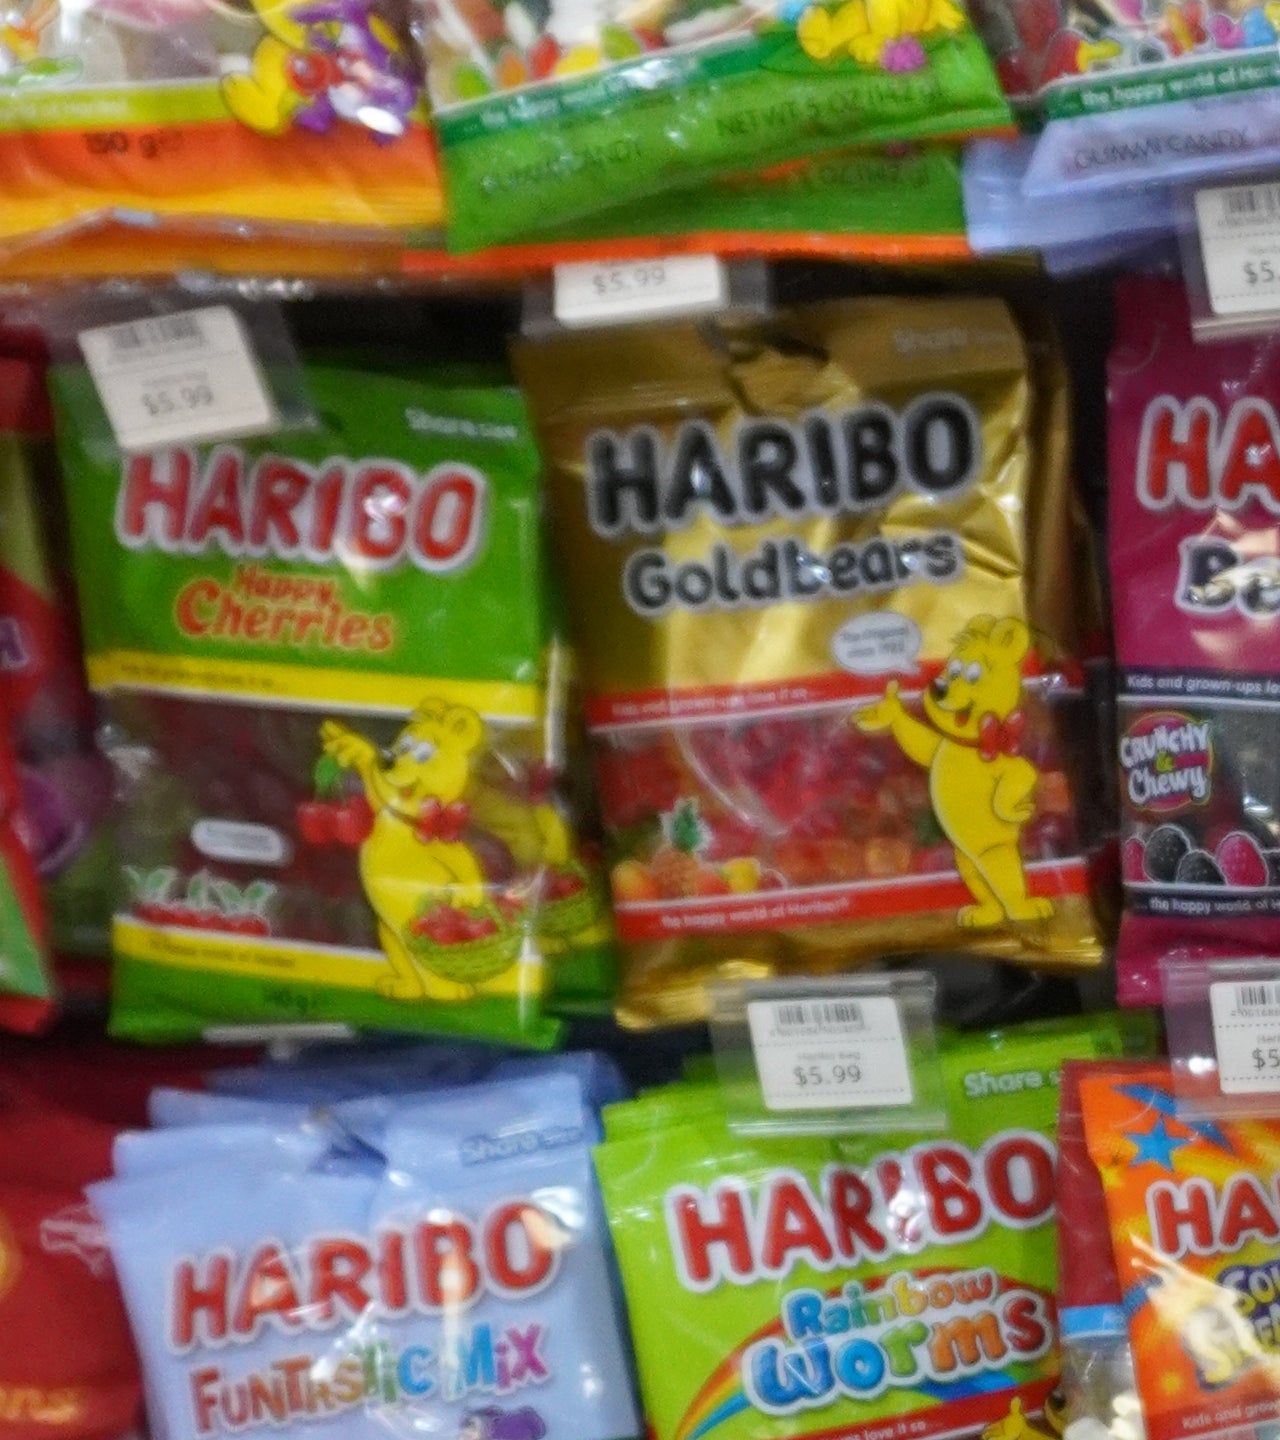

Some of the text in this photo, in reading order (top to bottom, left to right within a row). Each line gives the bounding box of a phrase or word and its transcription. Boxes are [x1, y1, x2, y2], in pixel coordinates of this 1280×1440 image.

[585, 389, 982, 540] HARIBO
[117, 444, 488, 573] HARIBO
[231, 564, 340, 612] Happy
[625, 529, 965, 618] Goldbears
[176, 580, 395, 654] Cherries
[1127, 675, 1154, 690] Kids
[1156, 676, 1183, 690] and
[1187, 679, 1263, 695] grown-ups
[1120, 721, 1211, 768] CRUNCHY
[1128, 767, 1212, 805] Chewy
[1172, 898, 1252, 913] happy world
[793, 1065, 862, 1087] $5.99
[964, 1066, 1045, 1099] Share
[666, 1129, 1058, 1292] HARIBO
[166, 1197, 562, 1353] HARIBO
[784, 1267, 998, 1340] Rainbow
